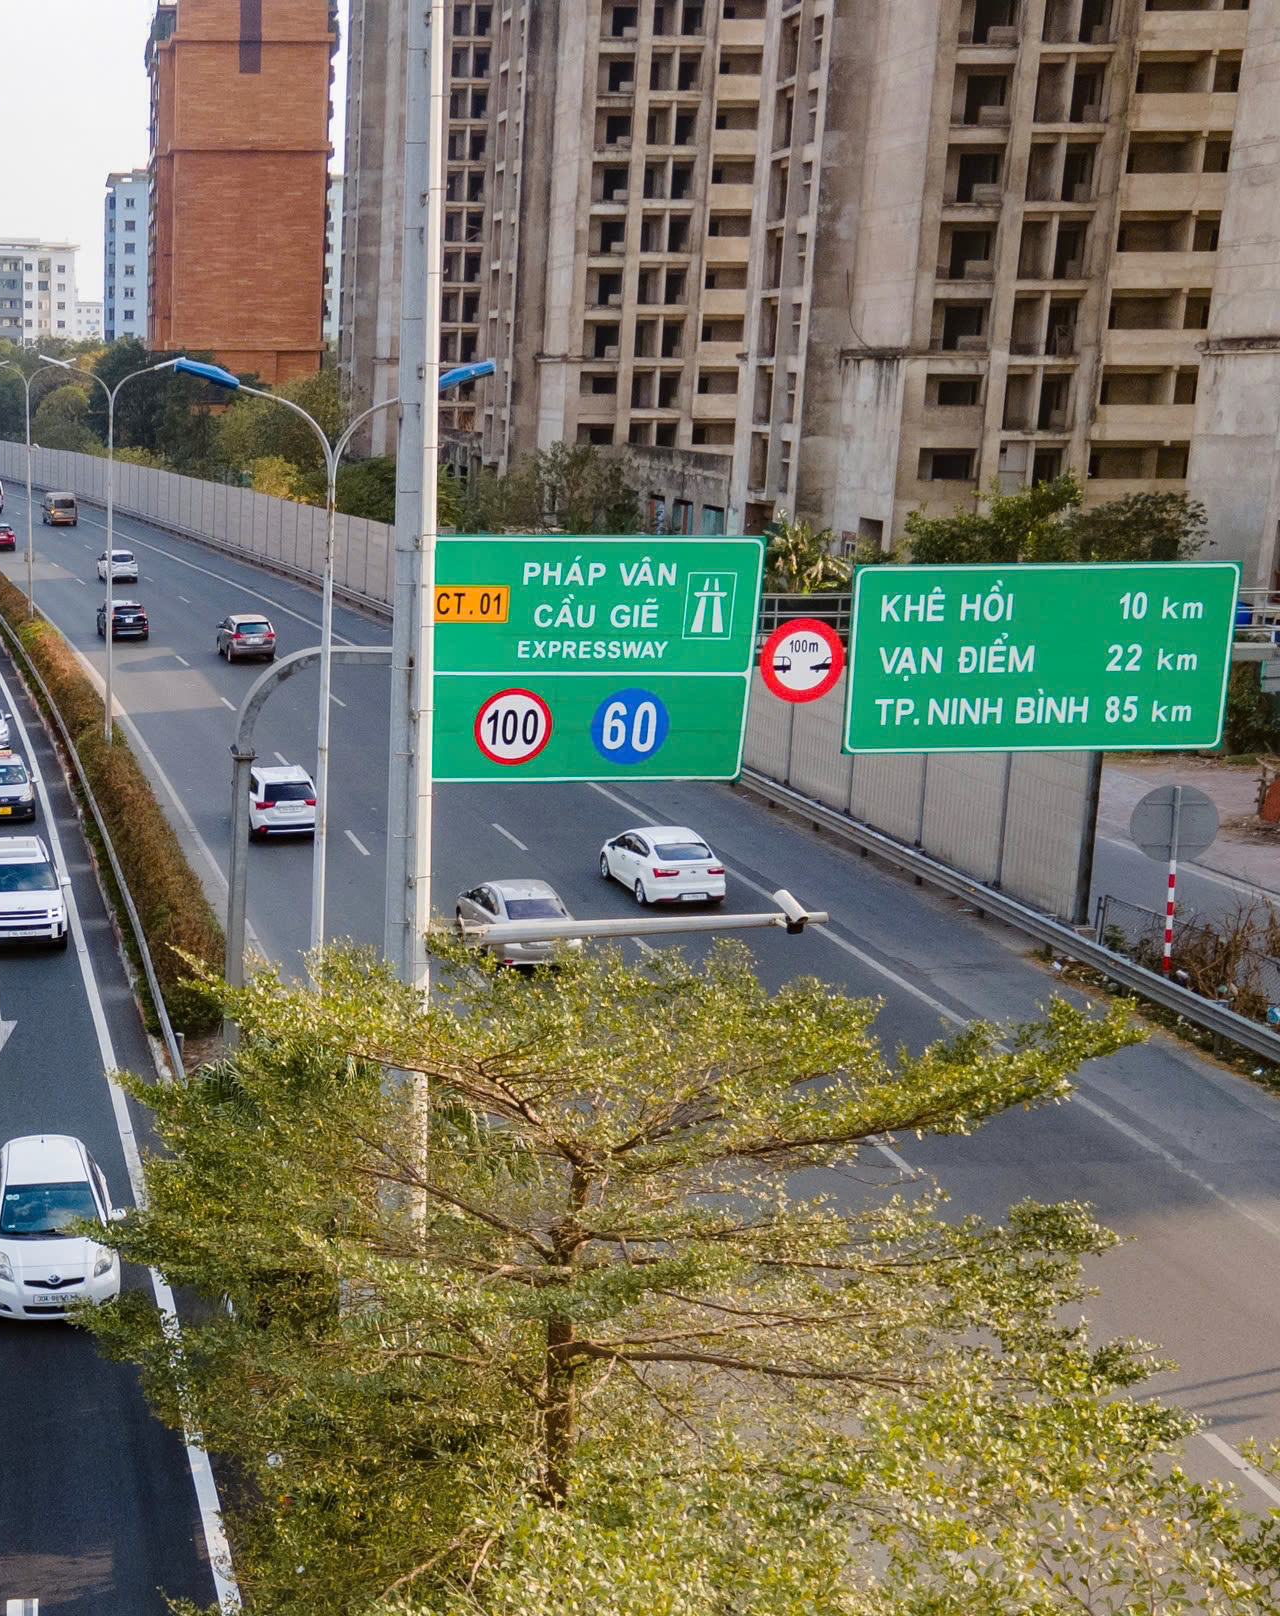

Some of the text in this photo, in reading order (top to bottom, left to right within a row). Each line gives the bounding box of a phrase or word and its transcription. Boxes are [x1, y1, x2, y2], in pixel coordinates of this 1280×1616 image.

[522, 555, 677, 587] PHÁP VÂN
[436, 592, 501, 616] CT.01
[533, 593, 659, 629] CẦU GIẼ
[880, 579, 1014, 622] KHÊ HỒI
[1119, 591, 1203, 620] 10 km
[517, 640, 669, 659] EXPRESSWAY
[789, 639, 819, 653] 100m
[879, 632, 1035, 682] VẠN ĐIỂM
[1105, 643, 1198, 672] 22 km
[1015, 688, 1089, 724] BÌNH
[1104, 695, 1192, 723] 85 km
[487, 708, 539, 746] 100
[602, 701, 657, 753] 60
